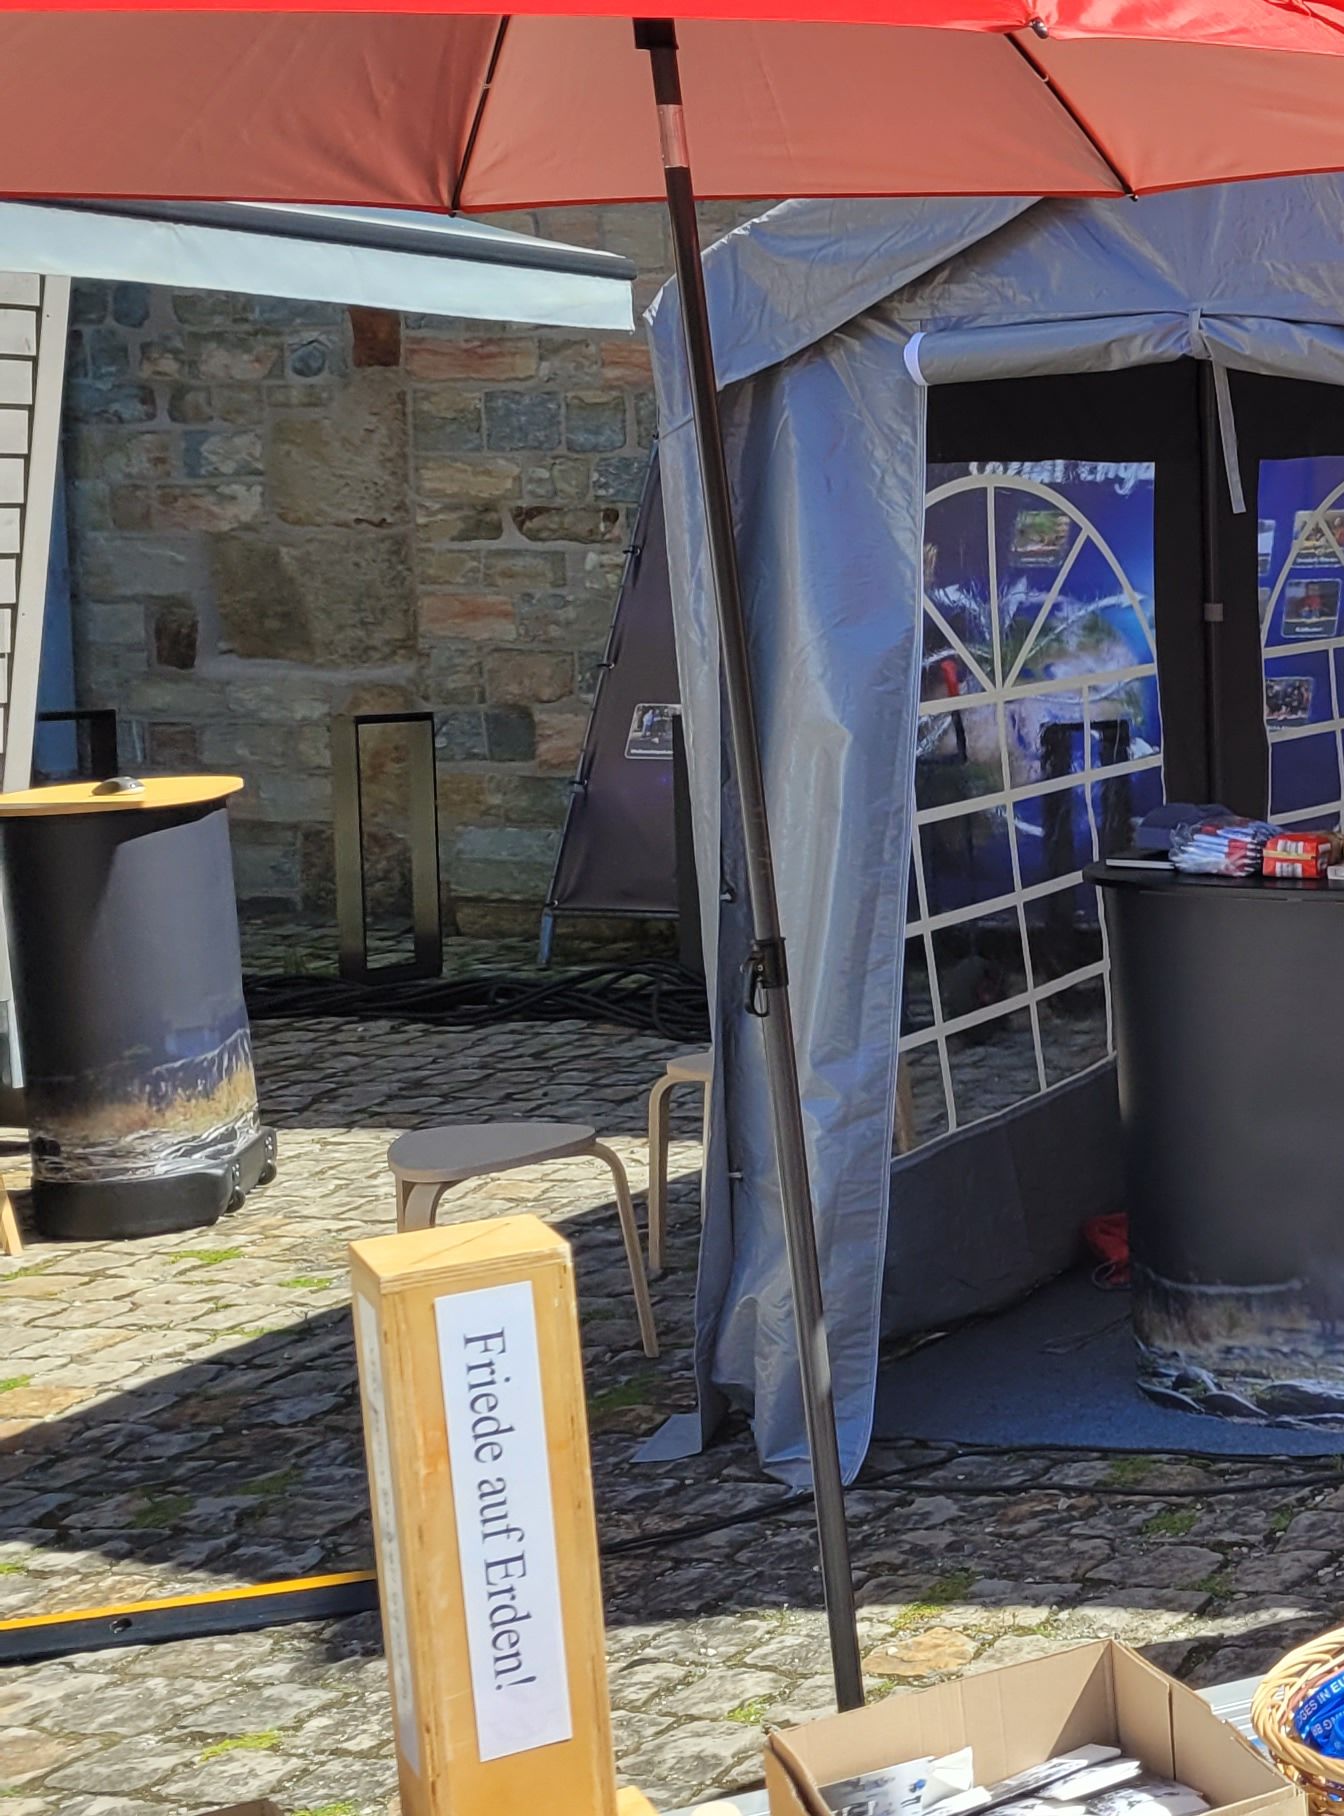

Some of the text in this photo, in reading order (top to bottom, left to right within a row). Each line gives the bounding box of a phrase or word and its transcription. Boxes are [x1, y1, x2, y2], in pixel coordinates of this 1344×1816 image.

[463, 1326, 538, 1692] Friede auf Erden!
